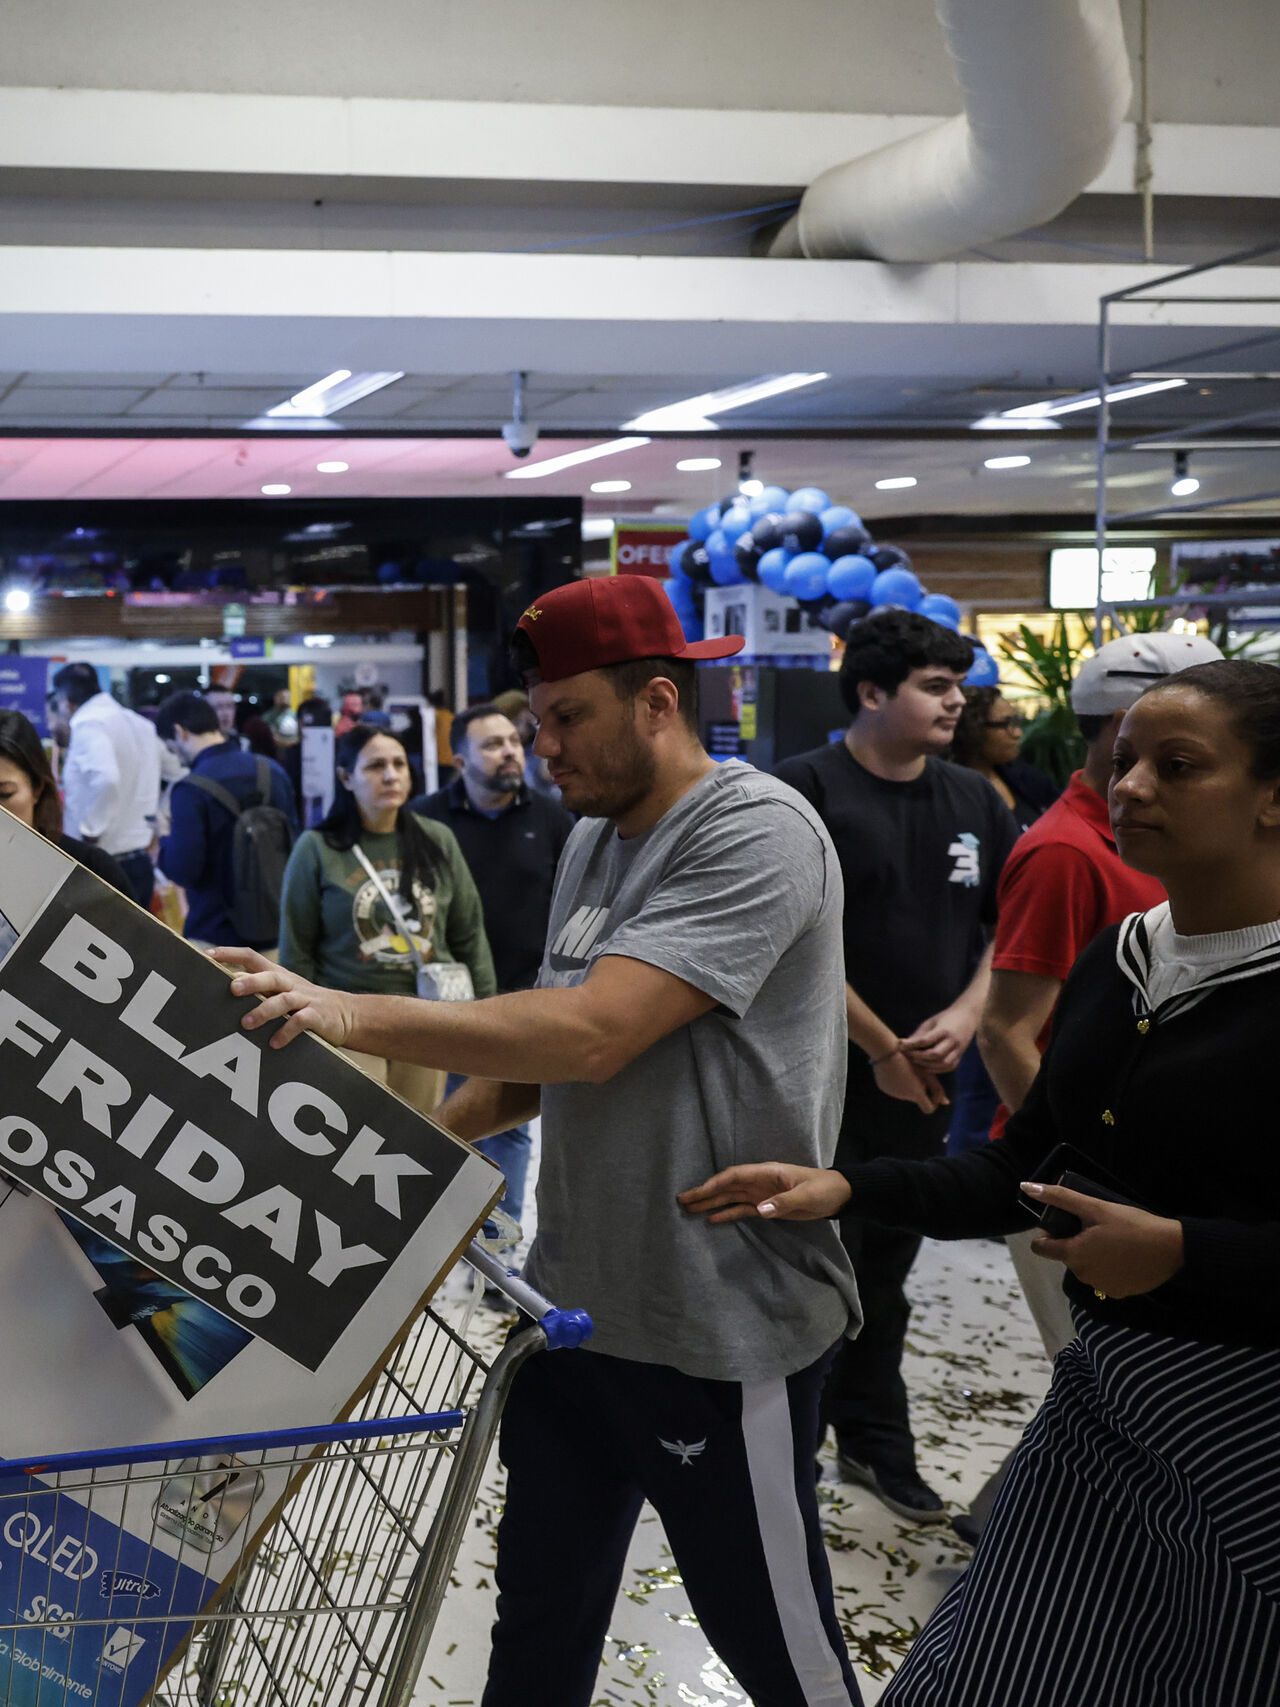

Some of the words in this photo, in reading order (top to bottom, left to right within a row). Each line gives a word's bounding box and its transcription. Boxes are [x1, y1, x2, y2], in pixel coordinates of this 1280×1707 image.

[39, 912, 433, 1221] BLACK
[3, 1511, 99, 1581] QLED
[23, 1595, 75, 1639] SGS
[9, 1648, 93, 1699] Globalmente
